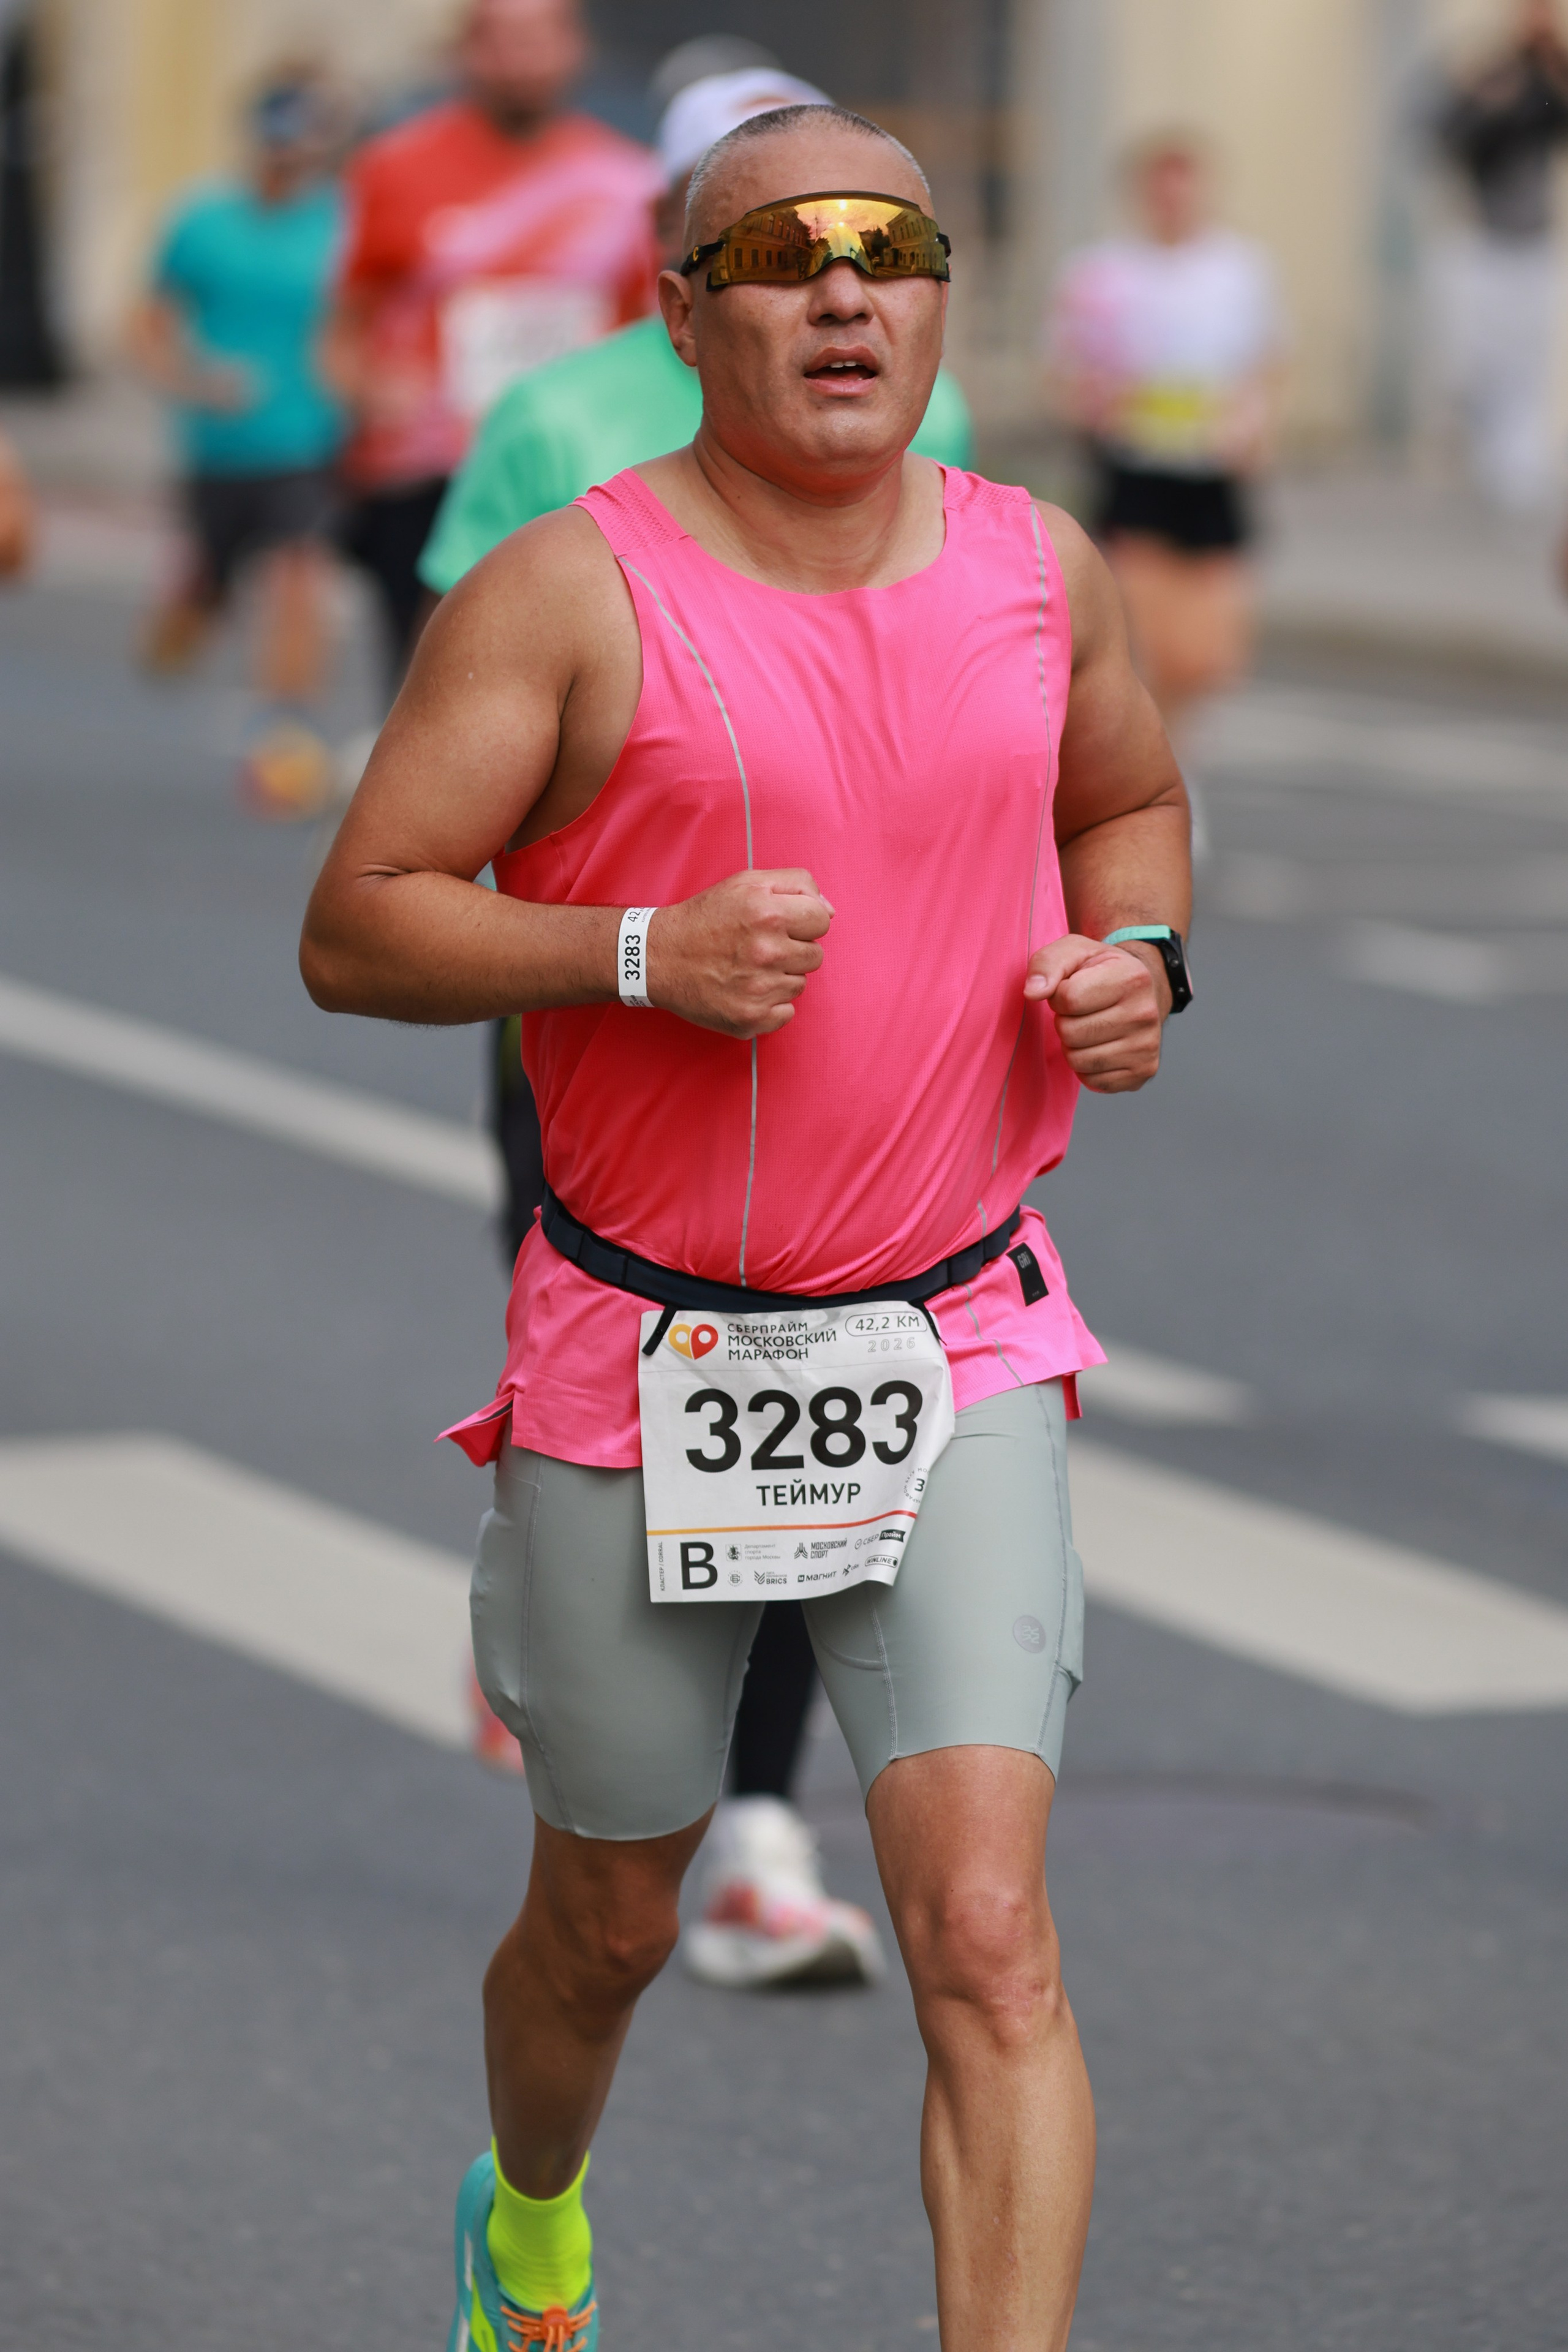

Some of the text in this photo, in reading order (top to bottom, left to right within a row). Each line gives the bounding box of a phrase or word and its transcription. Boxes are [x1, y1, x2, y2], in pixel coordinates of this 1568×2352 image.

[625, 935, 641, 980] 3283
[727, 1321, 808, 1333] СБЕРПРАЙМ
[855, 1315, 919, 1332] 42,2 КМ
[728, 1328, 837, 1347] МОСКОВСКИЙ
[867, 1337, 916, 1352] 2026
[728, 1348, 809, 1360] МАРАФОН
[684, 1380, 923, 1473] 3283
[756, 1479, 861, 1506] ТЕЙМУР
[810, 1537, 848, 1550] МОСКОВСКИЙ
[863, 1534, 879, 1545] СБЕР
[810, 1550, 829, 1559] СПОРТ
